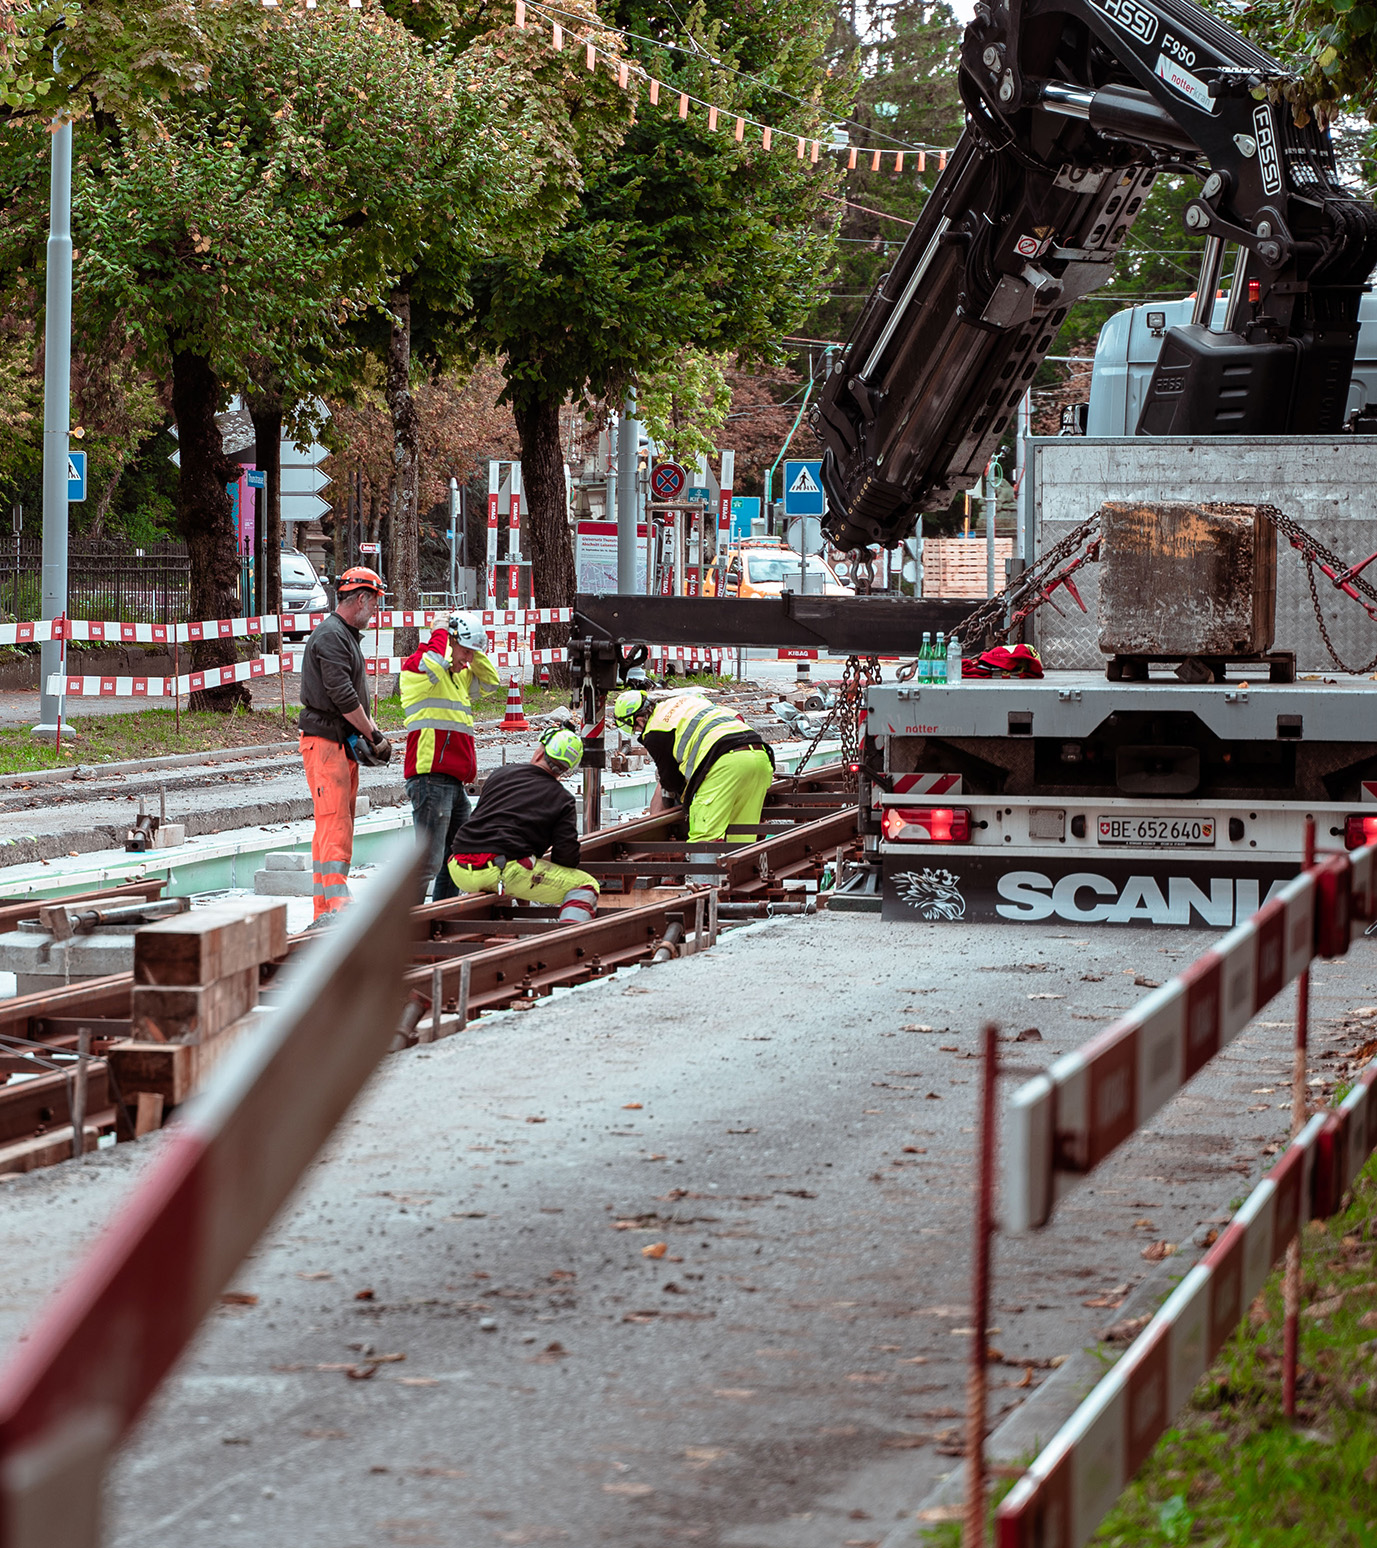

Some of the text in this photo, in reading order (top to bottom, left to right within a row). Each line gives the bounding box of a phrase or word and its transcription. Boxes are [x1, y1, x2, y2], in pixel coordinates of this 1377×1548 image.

[1104, 0, 1153, 39] ASSI
[1161, 33, 1196, 67] F950
[1255, 111, 1279, 189] FASSI
